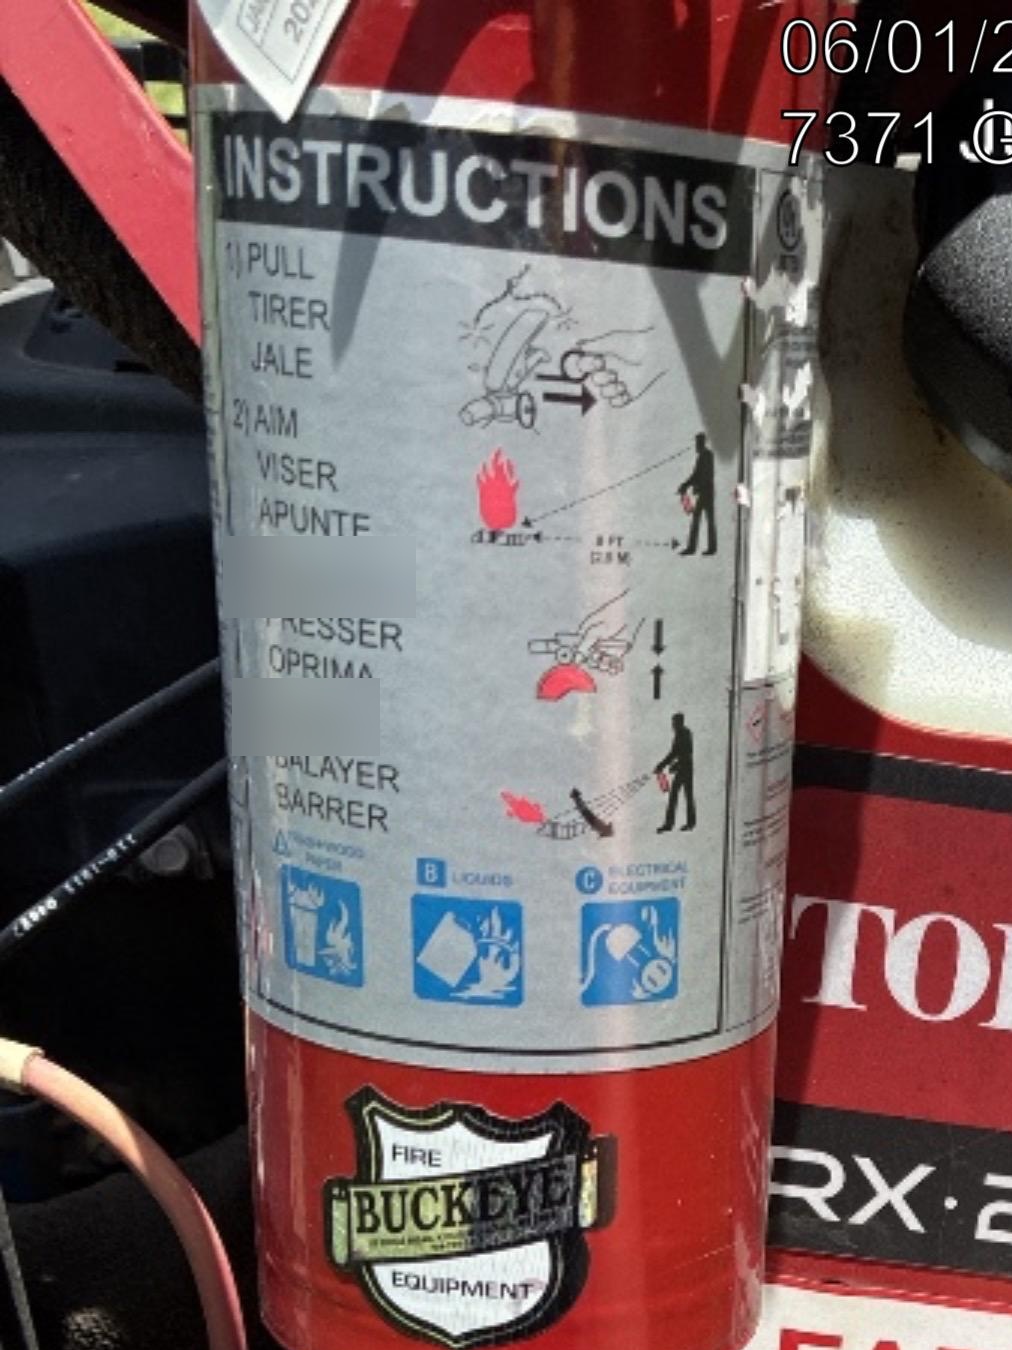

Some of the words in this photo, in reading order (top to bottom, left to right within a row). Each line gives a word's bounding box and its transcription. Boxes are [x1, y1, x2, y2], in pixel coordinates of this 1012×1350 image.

[223, 134, 728, 250] INSTRUCTIONS
[248, 242, 316, 280] PULL
[248, 290, 332, 333] TIRER
[251, 341, 314, 379] JALE
[254, 404, 298, 439] AIM
[256, 449, 339, 493] VISER
[275, 781, 390, 834] BARRER
[391, 1143, 443, 1168] FIRE
[353, 1164, 572, 1234] BUCKEYE
[391, 1270, 532, 1301] EQUIPMENT
